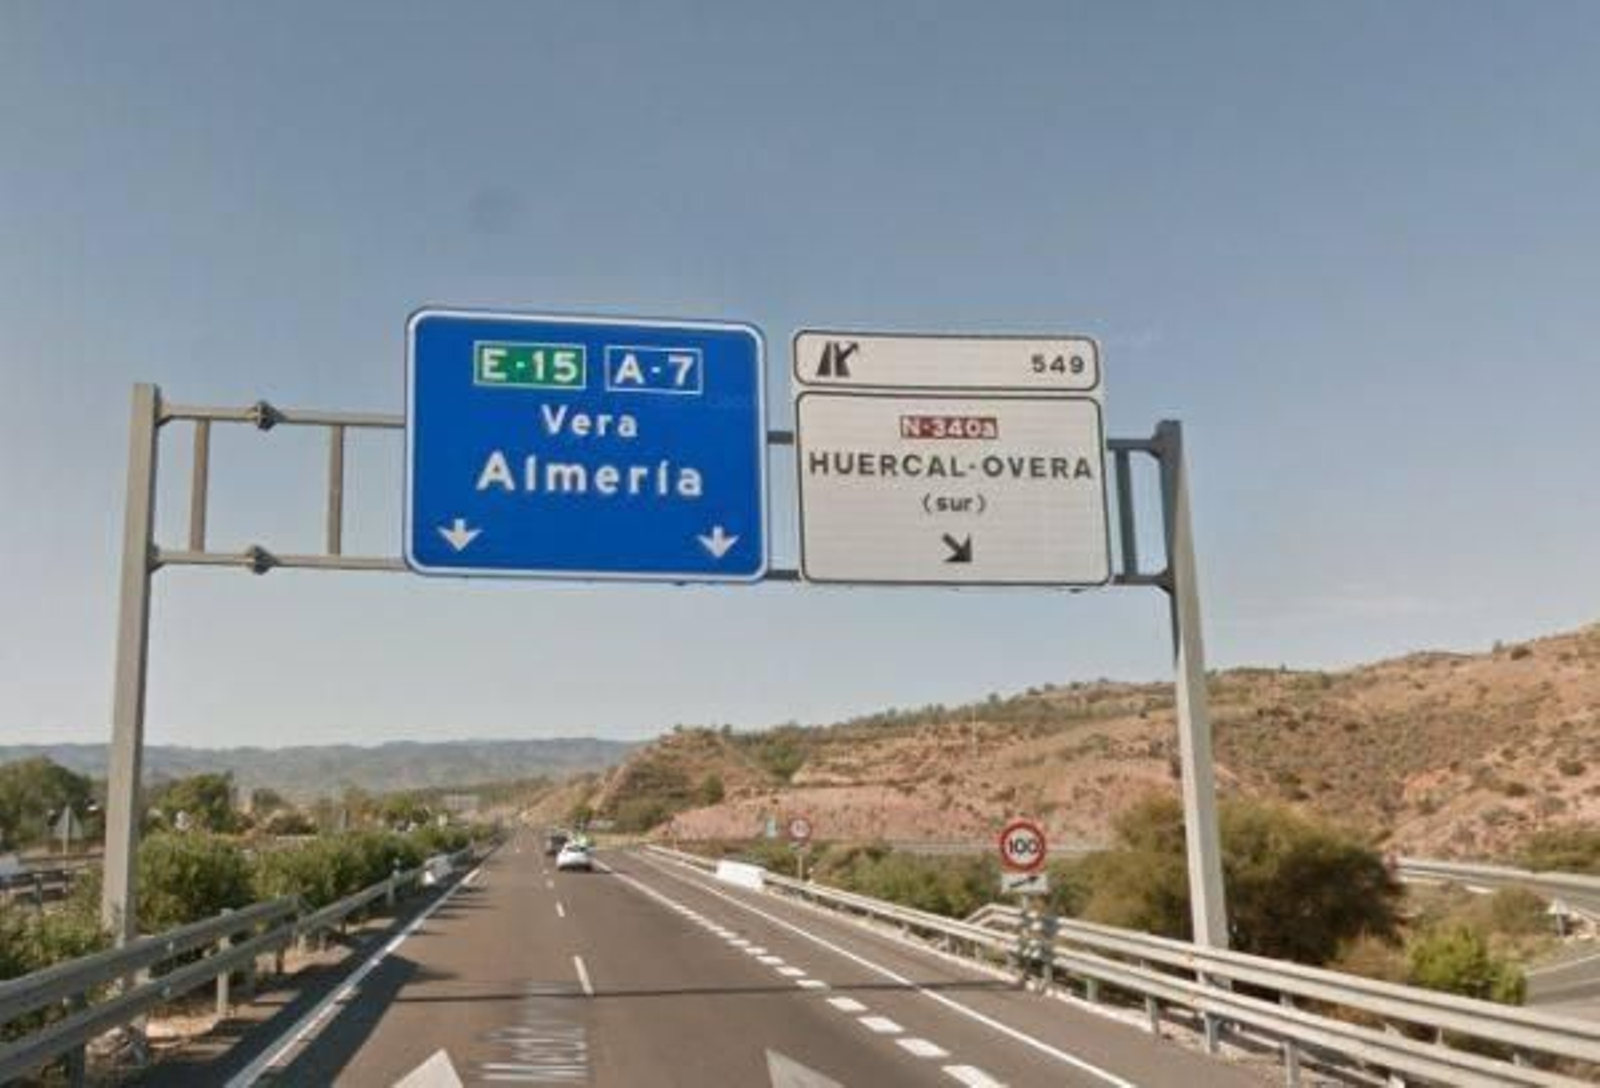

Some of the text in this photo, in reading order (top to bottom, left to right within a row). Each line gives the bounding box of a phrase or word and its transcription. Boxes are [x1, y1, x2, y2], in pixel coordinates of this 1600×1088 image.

[481, 348, 695, 386] E-15 A-7
[1031, 354, 1085, 374] 549
[541, 403, 639, 438] Vera
[902, 418, 997, 438] N-340a
[475, 450, 704, 497] Almería
[921, 492, 987, 514] (sur)
[1008, 837, 1039, 856] 100
